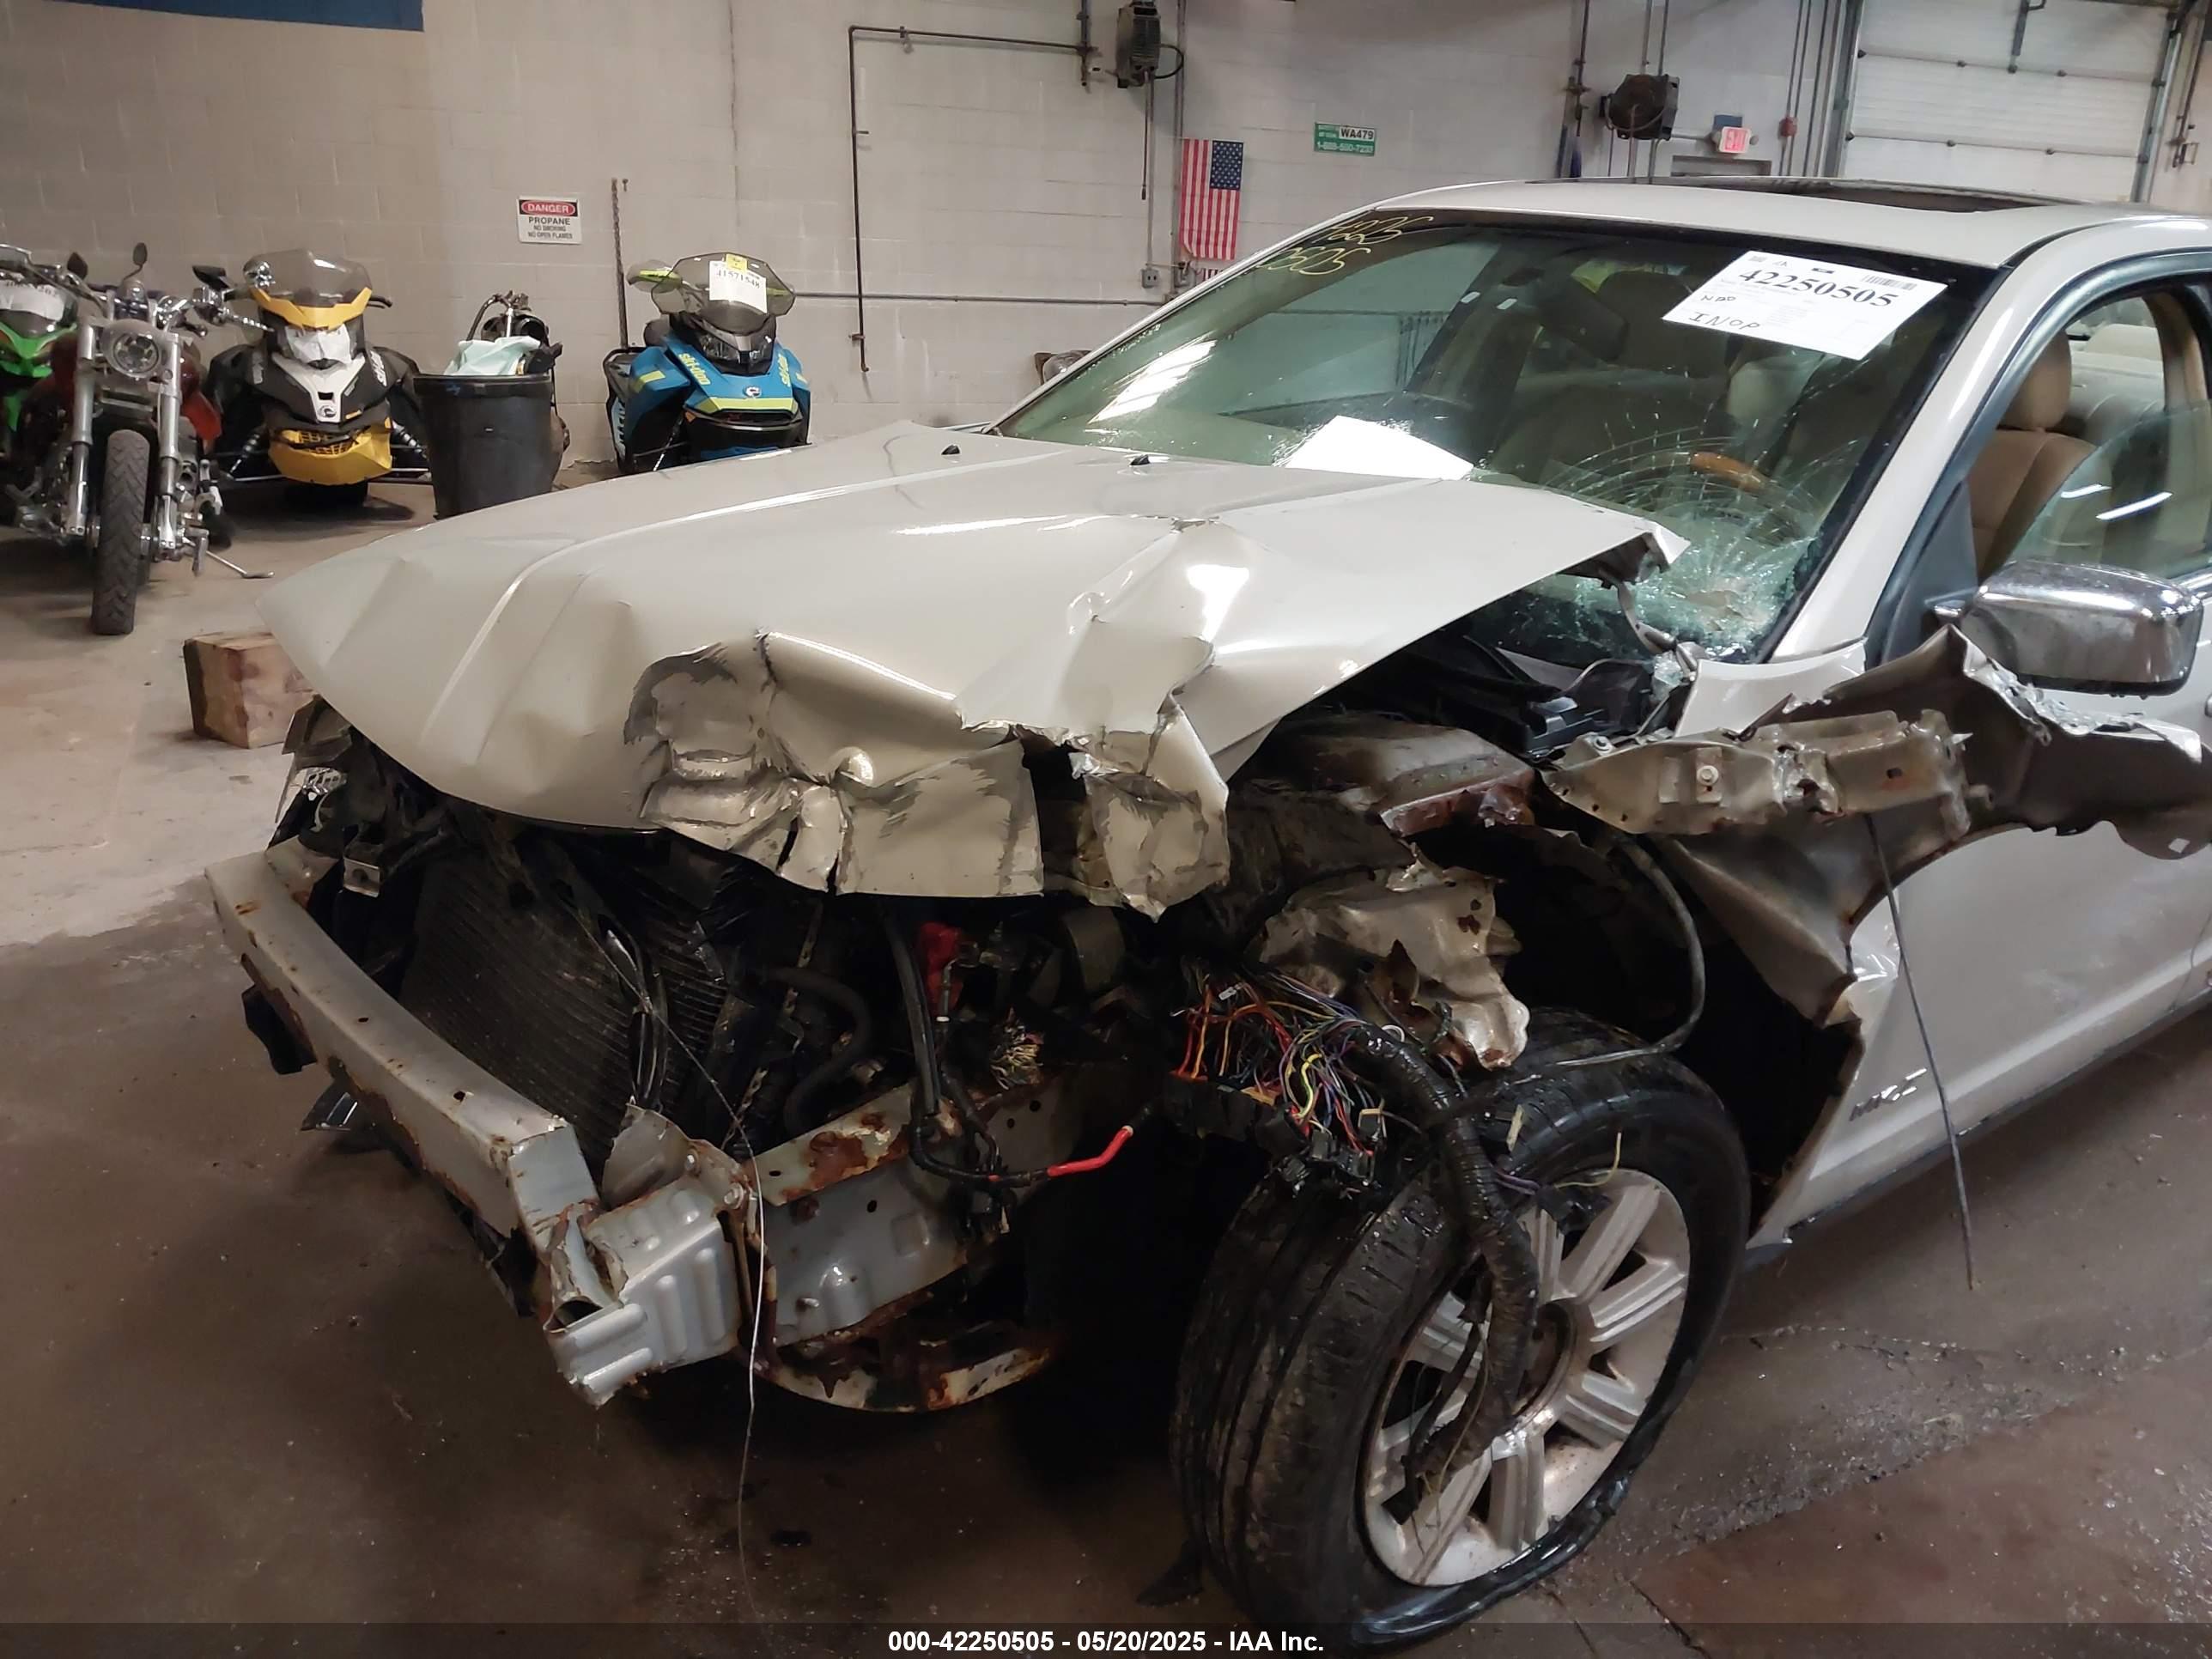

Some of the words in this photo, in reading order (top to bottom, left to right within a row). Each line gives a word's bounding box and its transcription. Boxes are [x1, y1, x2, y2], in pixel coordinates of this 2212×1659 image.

[1340, 128, 1374, 140] WA479
[527, 204, 569, 213] DANGER
[528, 216, 571, 226] PROPANE
[1739, 270, 1899, 307] 42250505
[1688, 311, 1761, 331] INOP
